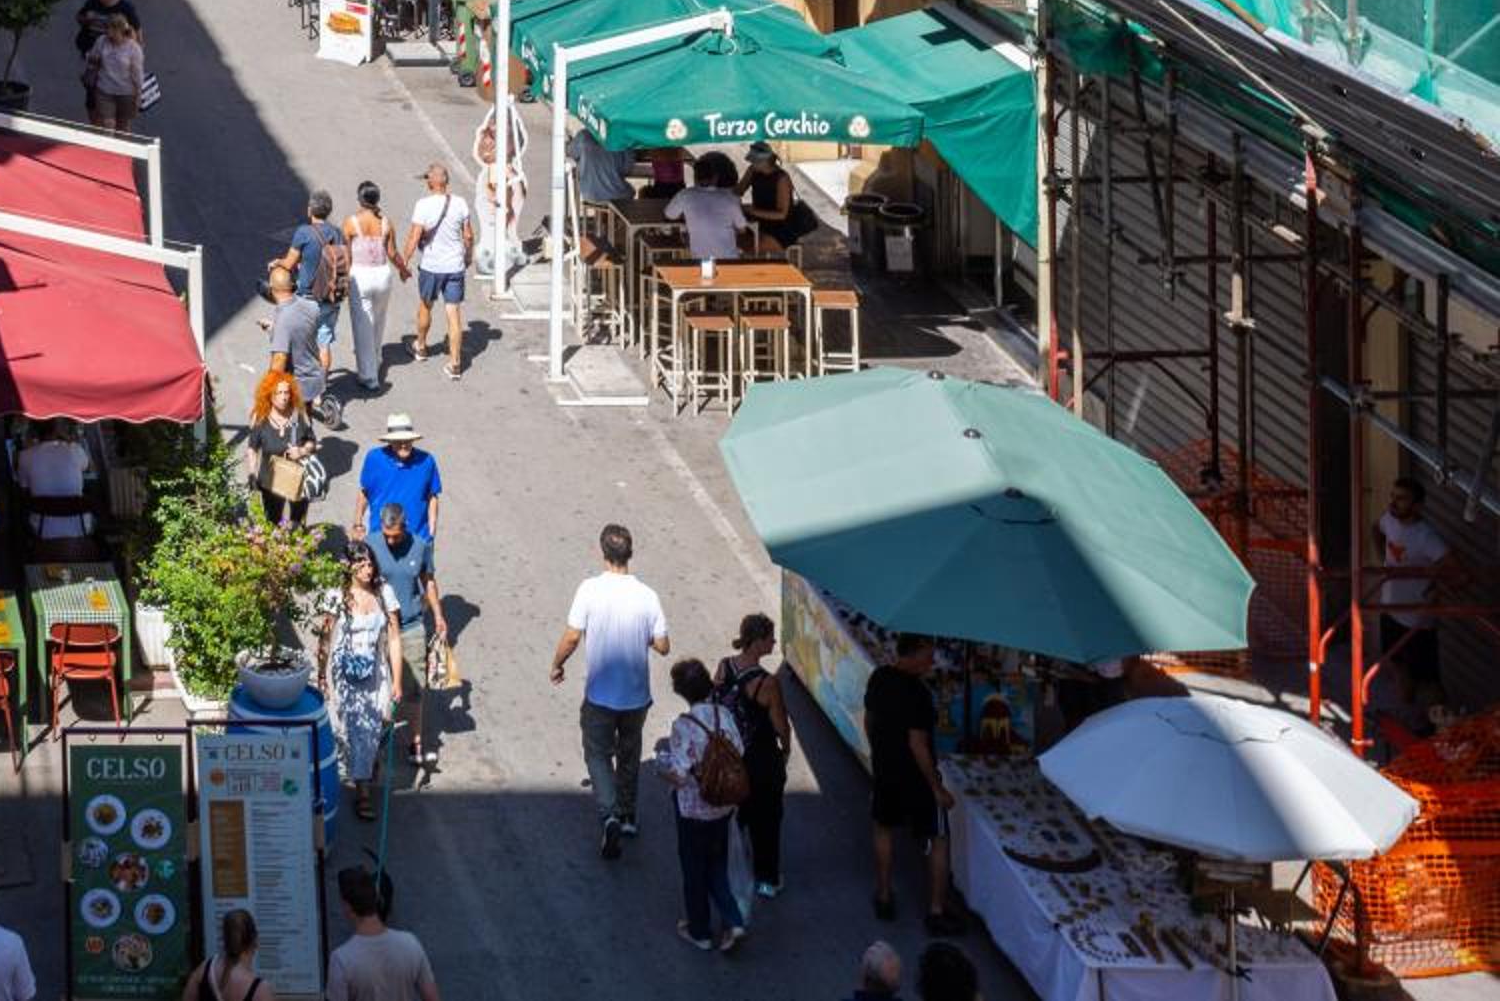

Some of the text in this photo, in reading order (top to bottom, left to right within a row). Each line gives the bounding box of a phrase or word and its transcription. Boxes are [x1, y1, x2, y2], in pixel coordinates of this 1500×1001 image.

[705, 111, 831, 137] Terzo Cerchio
[226, 743, 285, 759] CELSO
[86, 757, 167, 779] CELSO
